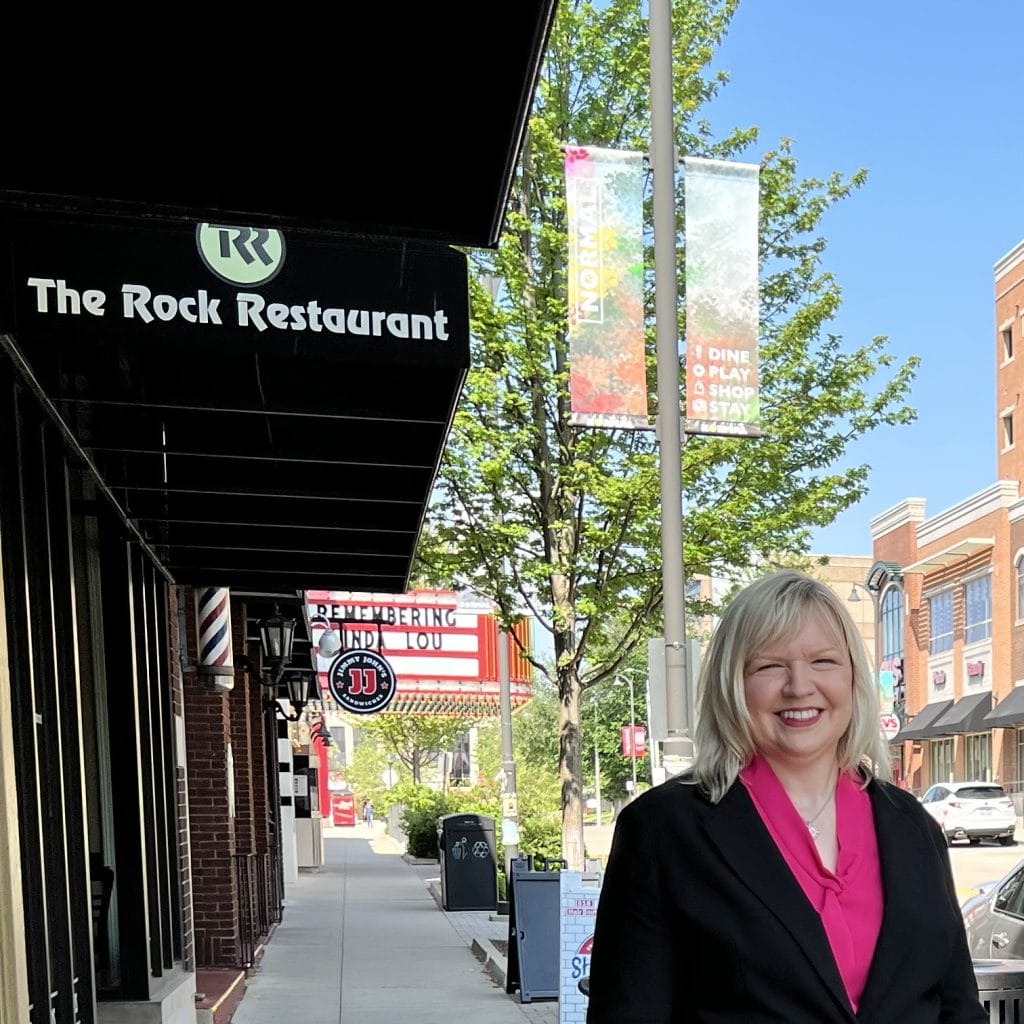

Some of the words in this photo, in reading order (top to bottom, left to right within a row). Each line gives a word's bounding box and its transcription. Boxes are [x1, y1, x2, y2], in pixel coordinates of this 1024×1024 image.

[579, 185, 599, 312] NORMAL
[27, 277, 107, 316] The
[120, 284, 224, 325] Rock
[236, 292, 450, 342] Restaurant
[708, 347, 750, 364] DINE
[708, 365, 752, 382] PLAY
[709, 383, 755, 398] SHOP
[709, 401, 751, 417] STAY
[316, 604, 457, 628] REMEMBERING
[344, 631, 387, 649] INDA
[406, 632, 443, 650] LOU
[336, 655, 360, 677] JIMMY
[348, 668, 377, 695] JJ
